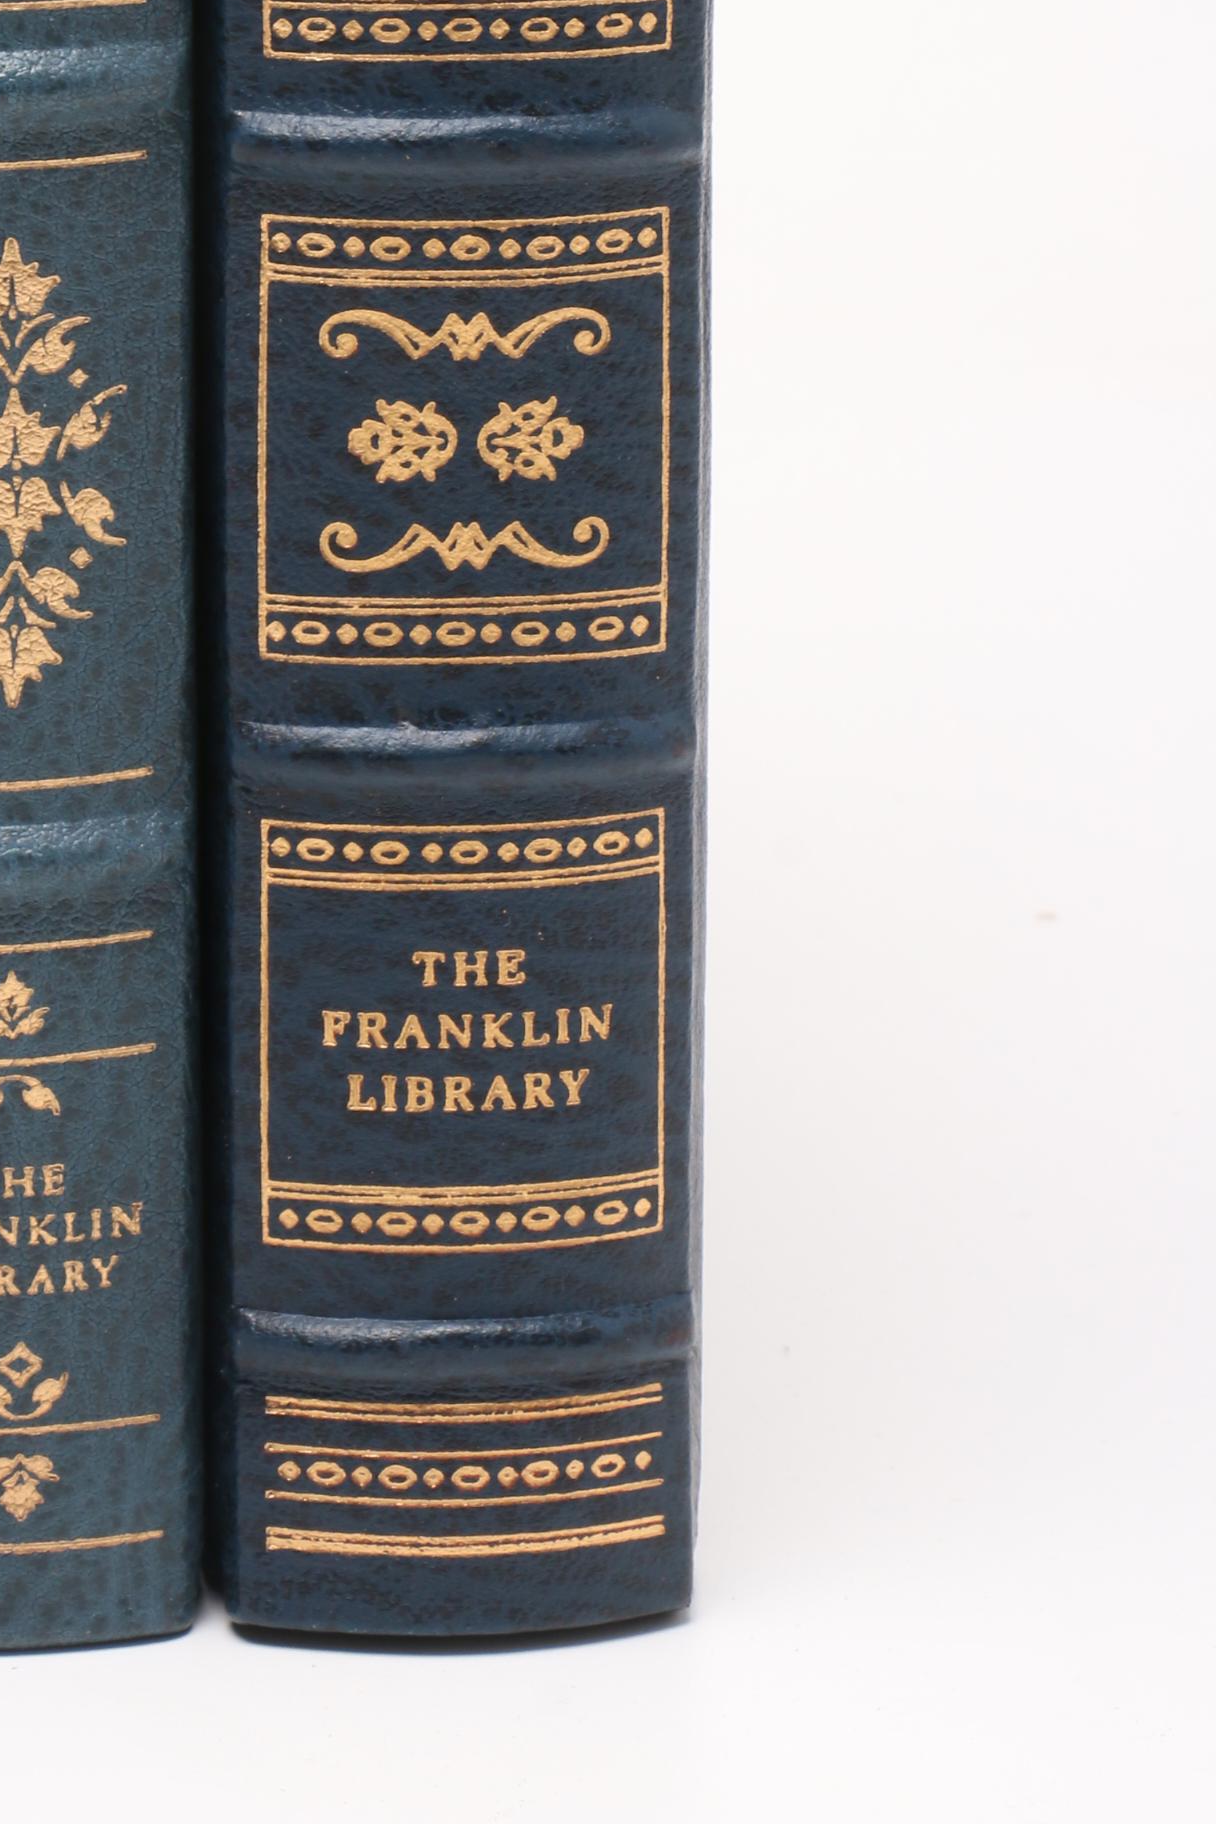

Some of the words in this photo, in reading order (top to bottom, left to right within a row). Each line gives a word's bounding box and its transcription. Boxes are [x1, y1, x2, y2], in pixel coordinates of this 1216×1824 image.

[411, 949, 527, 988] THE
[321, 1003, 613, 1050] FRANKLIN
[346, 1068, 590, 1113] LIBRARY
